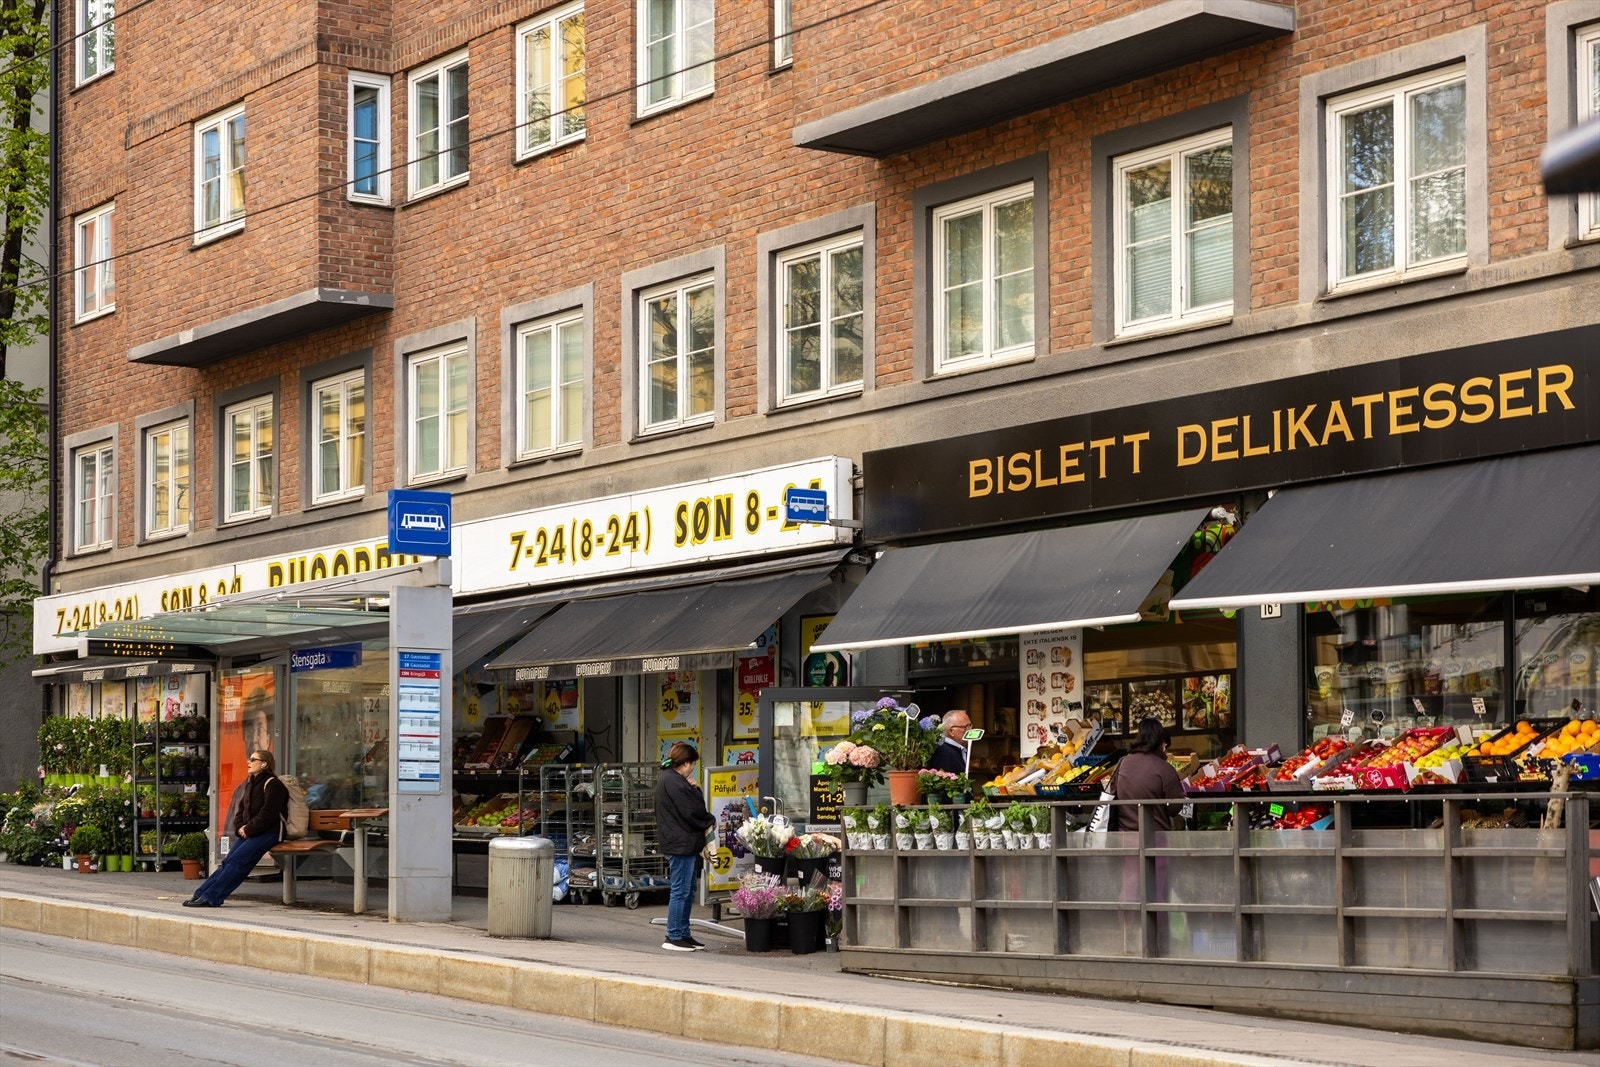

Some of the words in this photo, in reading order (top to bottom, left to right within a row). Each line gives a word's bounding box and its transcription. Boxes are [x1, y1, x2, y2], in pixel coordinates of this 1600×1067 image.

[968, 430, 1151, 499] BISLETT
[1176, 363, 1577, 467] DELIKATESSER
[509, 505, 652, 571] 7-24(8-24)
[674, 493, 734, 547] SØN
[745, 478, 823, 535] 8-
[160, 585, 193, 613] SØN
[1023, 638, 1038, 646] EKTE
[1038, 635, 1069, 645] ITALIENSK
[291, 652, 326, 669] Stensgata
[714, 784, 737, 794] Påfyll
[820, 793, 844, 803] 11-2
